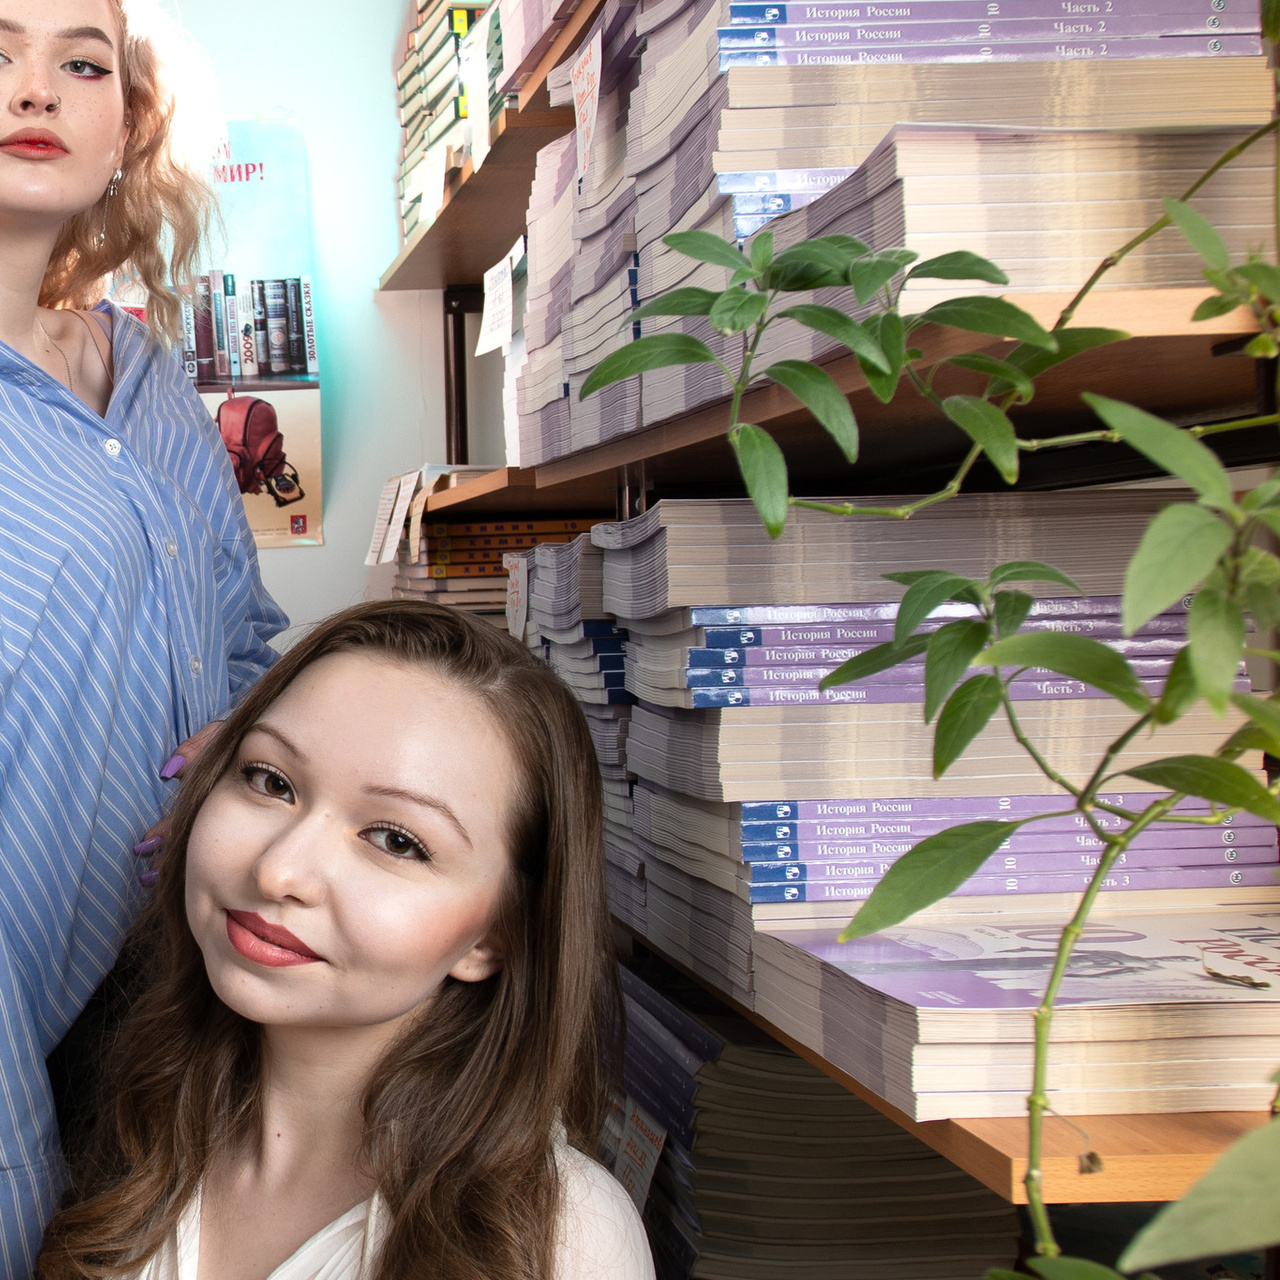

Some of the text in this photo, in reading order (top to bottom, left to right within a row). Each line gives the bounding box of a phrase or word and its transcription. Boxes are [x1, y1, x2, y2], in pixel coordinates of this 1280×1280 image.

[806, 2, 1113, 20] История России 10 Часть 2
[213, 162, 264, 183] МИР!
[781, 628, 877, 642] История России
[769, 683, 1086, 703] История России Часть 3
[817, 797, 1011, 816] История России 10
[816, 824, 911, 837] История России
[825, 857, 1017, 878] История 10
